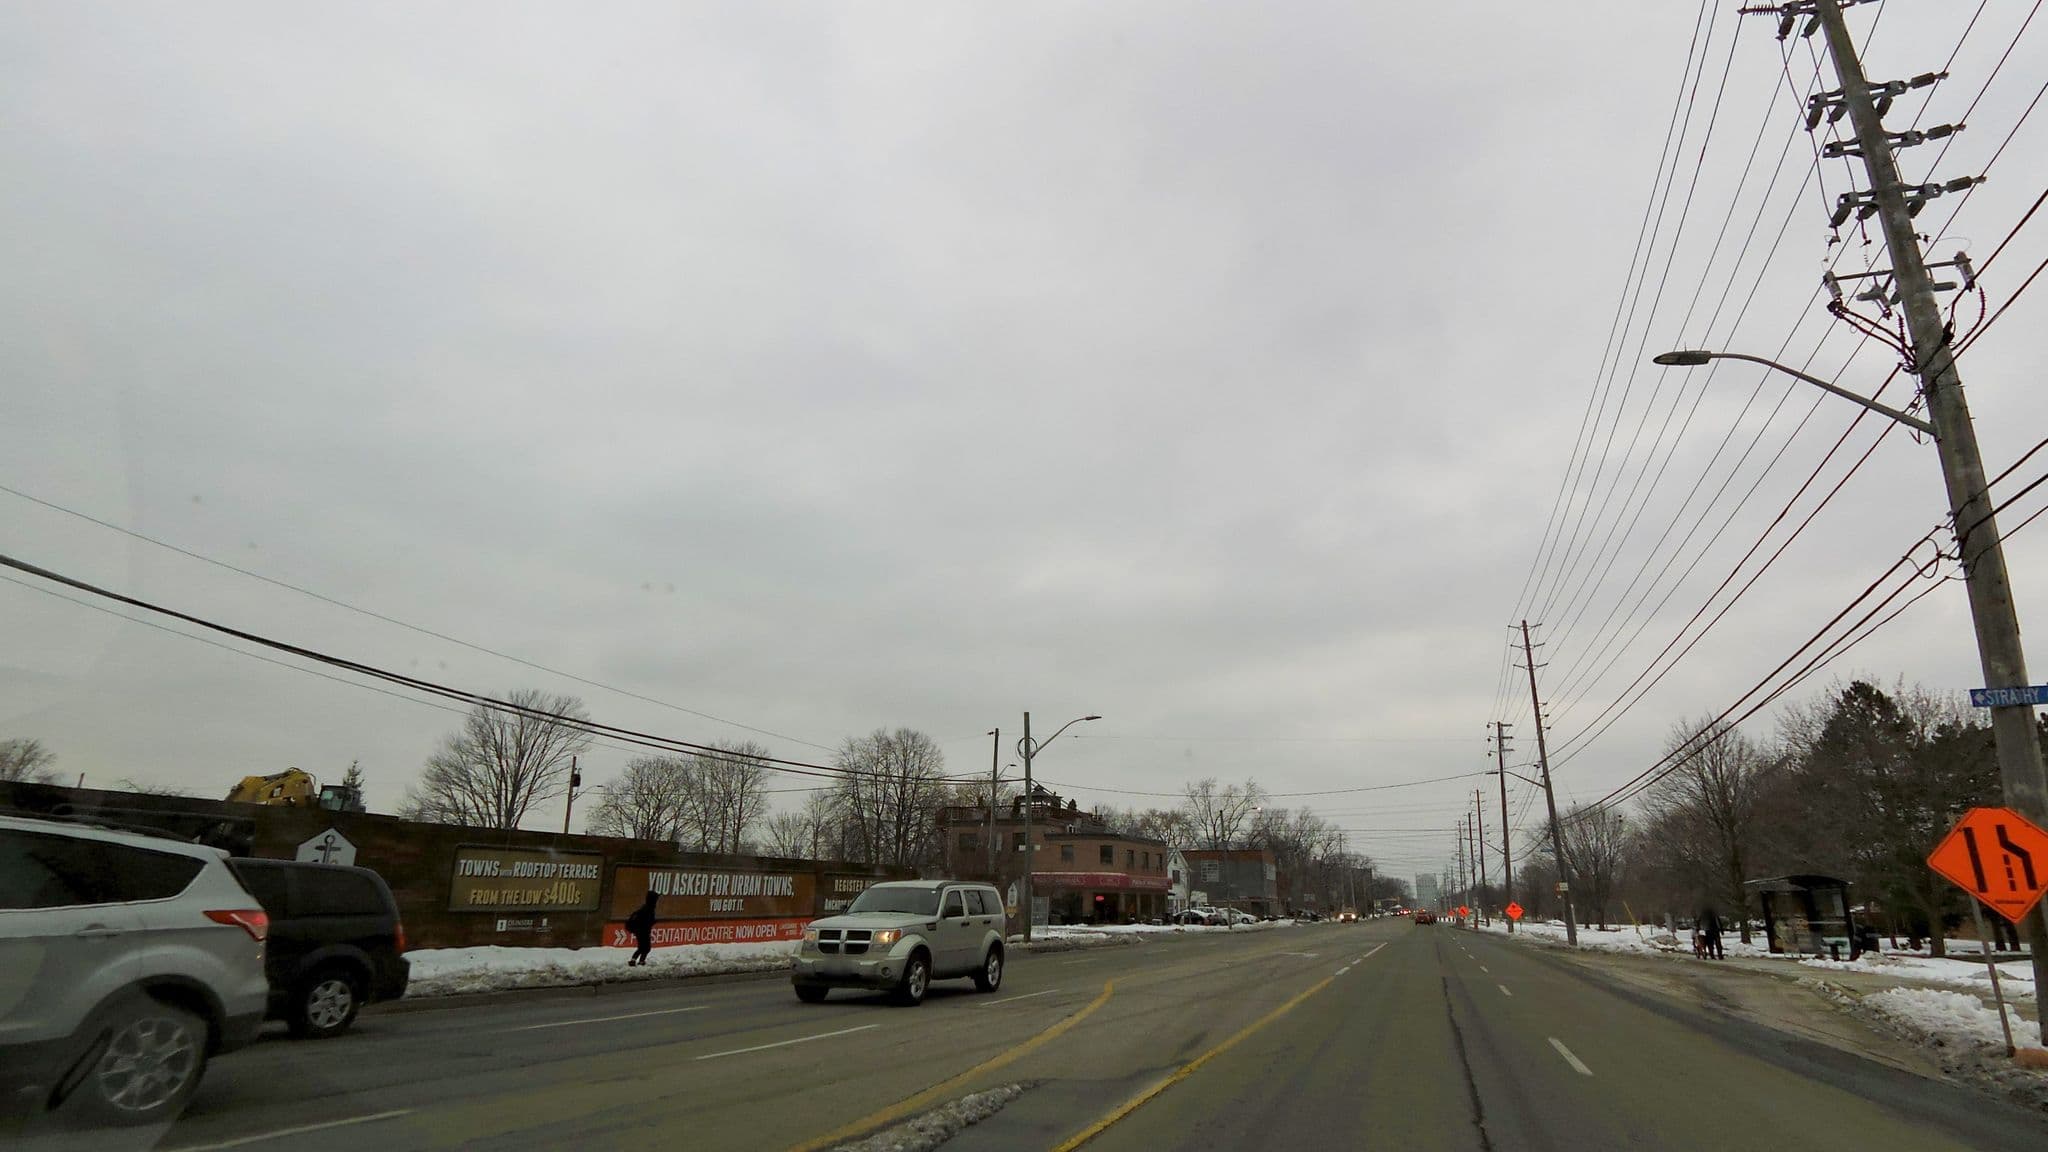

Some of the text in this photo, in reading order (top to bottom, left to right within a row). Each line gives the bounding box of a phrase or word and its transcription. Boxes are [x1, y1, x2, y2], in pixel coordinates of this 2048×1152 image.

[459, 860, 500, 877] TOWNS
[512, 861, 557, 878] ROOFTOP
[559, 863, 599, 879] TERRACE
[648, 872, 795, 897] YOU ASKED FOR URBAN TOWNS.
[834, 879, 865, 893] REGISTER
[469, 889, 499, 905] FROM
[500, 890, 520, 905] THE
[520, 890, 543, 905] LOW
[709, 898, 722, 912] YOU
[722, 899, 737, 912] GOT
[701, 926, 733, 942] CENTRE
[735, 925, 756, 940] NOW
[756, 924, 777, 939] OPEN
